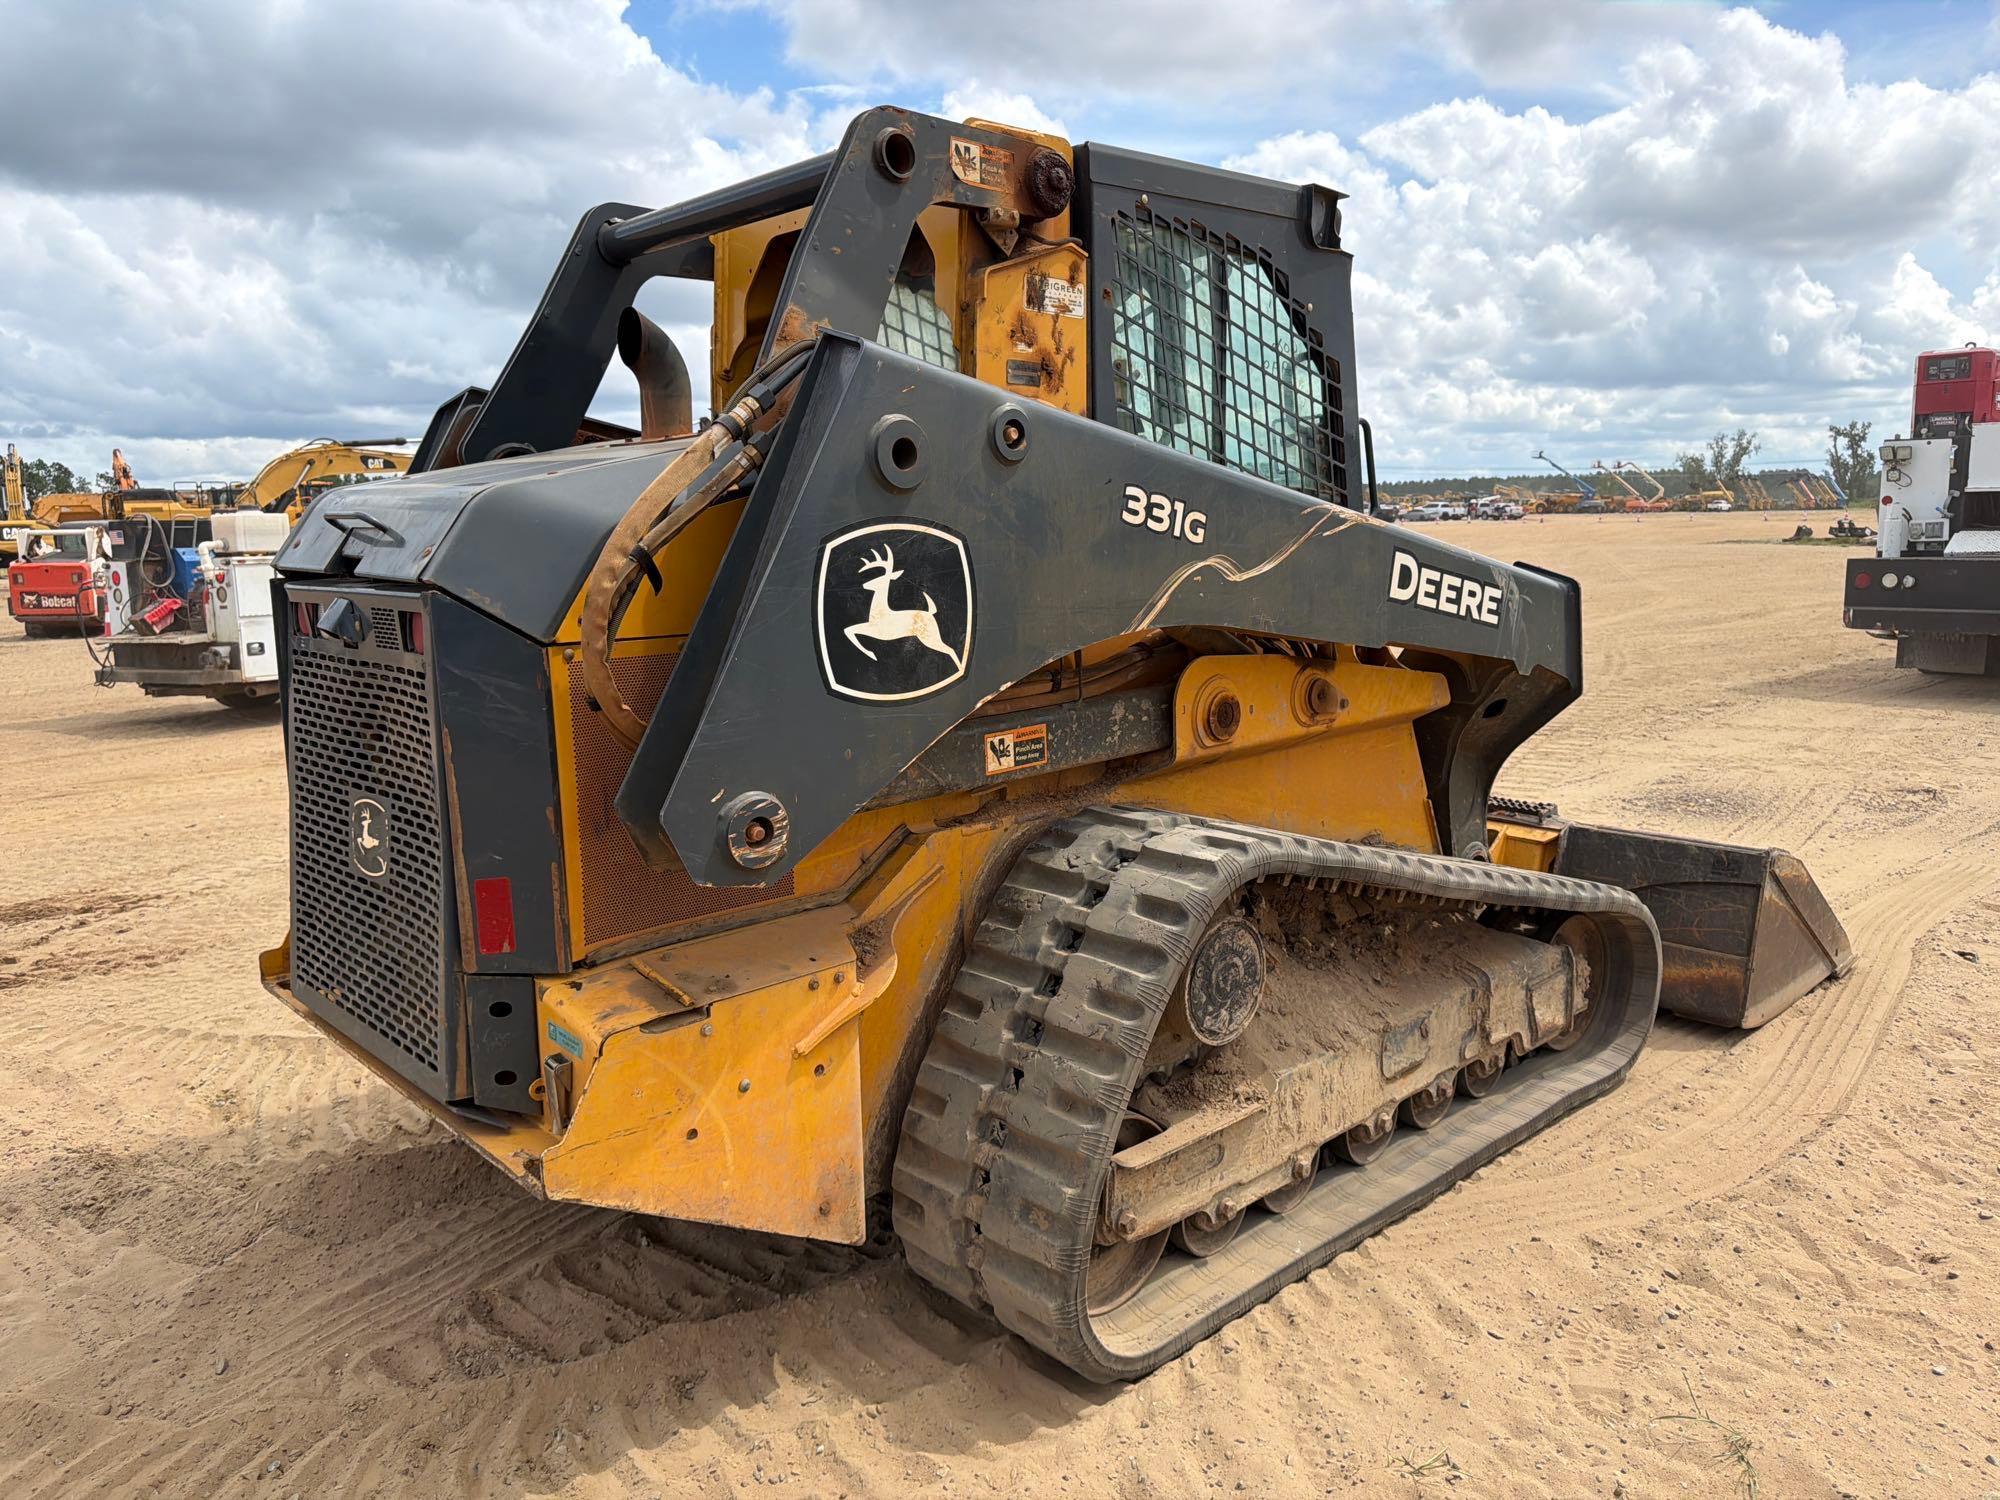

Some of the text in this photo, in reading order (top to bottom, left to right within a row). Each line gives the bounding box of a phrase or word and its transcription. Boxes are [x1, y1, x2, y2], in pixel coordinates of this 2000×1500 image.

[1039, 281, 1083, 295] RIGREEN
[367, 458, 385, 469] CAT
[1122, 486, 1207, 544] 331G
[2, 527, 30, 540] CA
[1389, 551, 1503, 625] DEERE
[41, 596, 76, 608] Bobcat
[1020, 728, 1044, 738] WARNING
[1015, 743, 1043, 753] Pinch Area
[1028, 752, 1040, 760] Away
